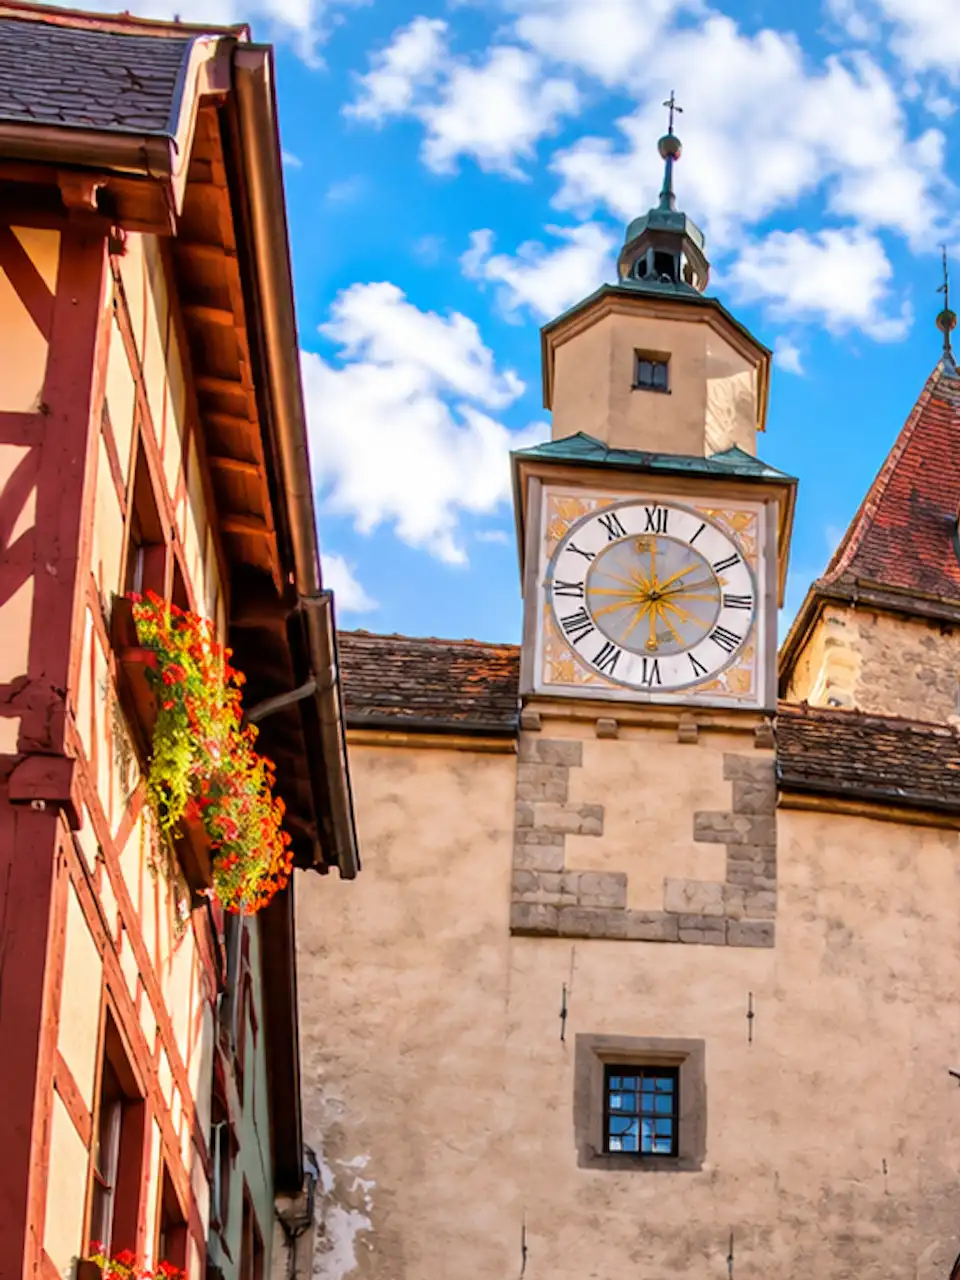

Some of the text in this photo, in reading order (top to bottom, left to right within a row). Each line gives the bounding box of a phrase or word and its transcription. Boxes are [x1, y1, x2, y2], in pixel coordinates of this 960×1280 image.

[597, 512, 627, 540] XI
[643, 507, 668, 533] XII
[689, 523, 706, 544] I
[566, 543, 595, 561] X
[713, 553, 741, 573] II
[553, 580, 584, 598] IX
[723, 593, 752, 610] III
[592, 641, 622, 675] VII
[688, 652, 708, 677] V
[642, 657, 662, 686] VI
